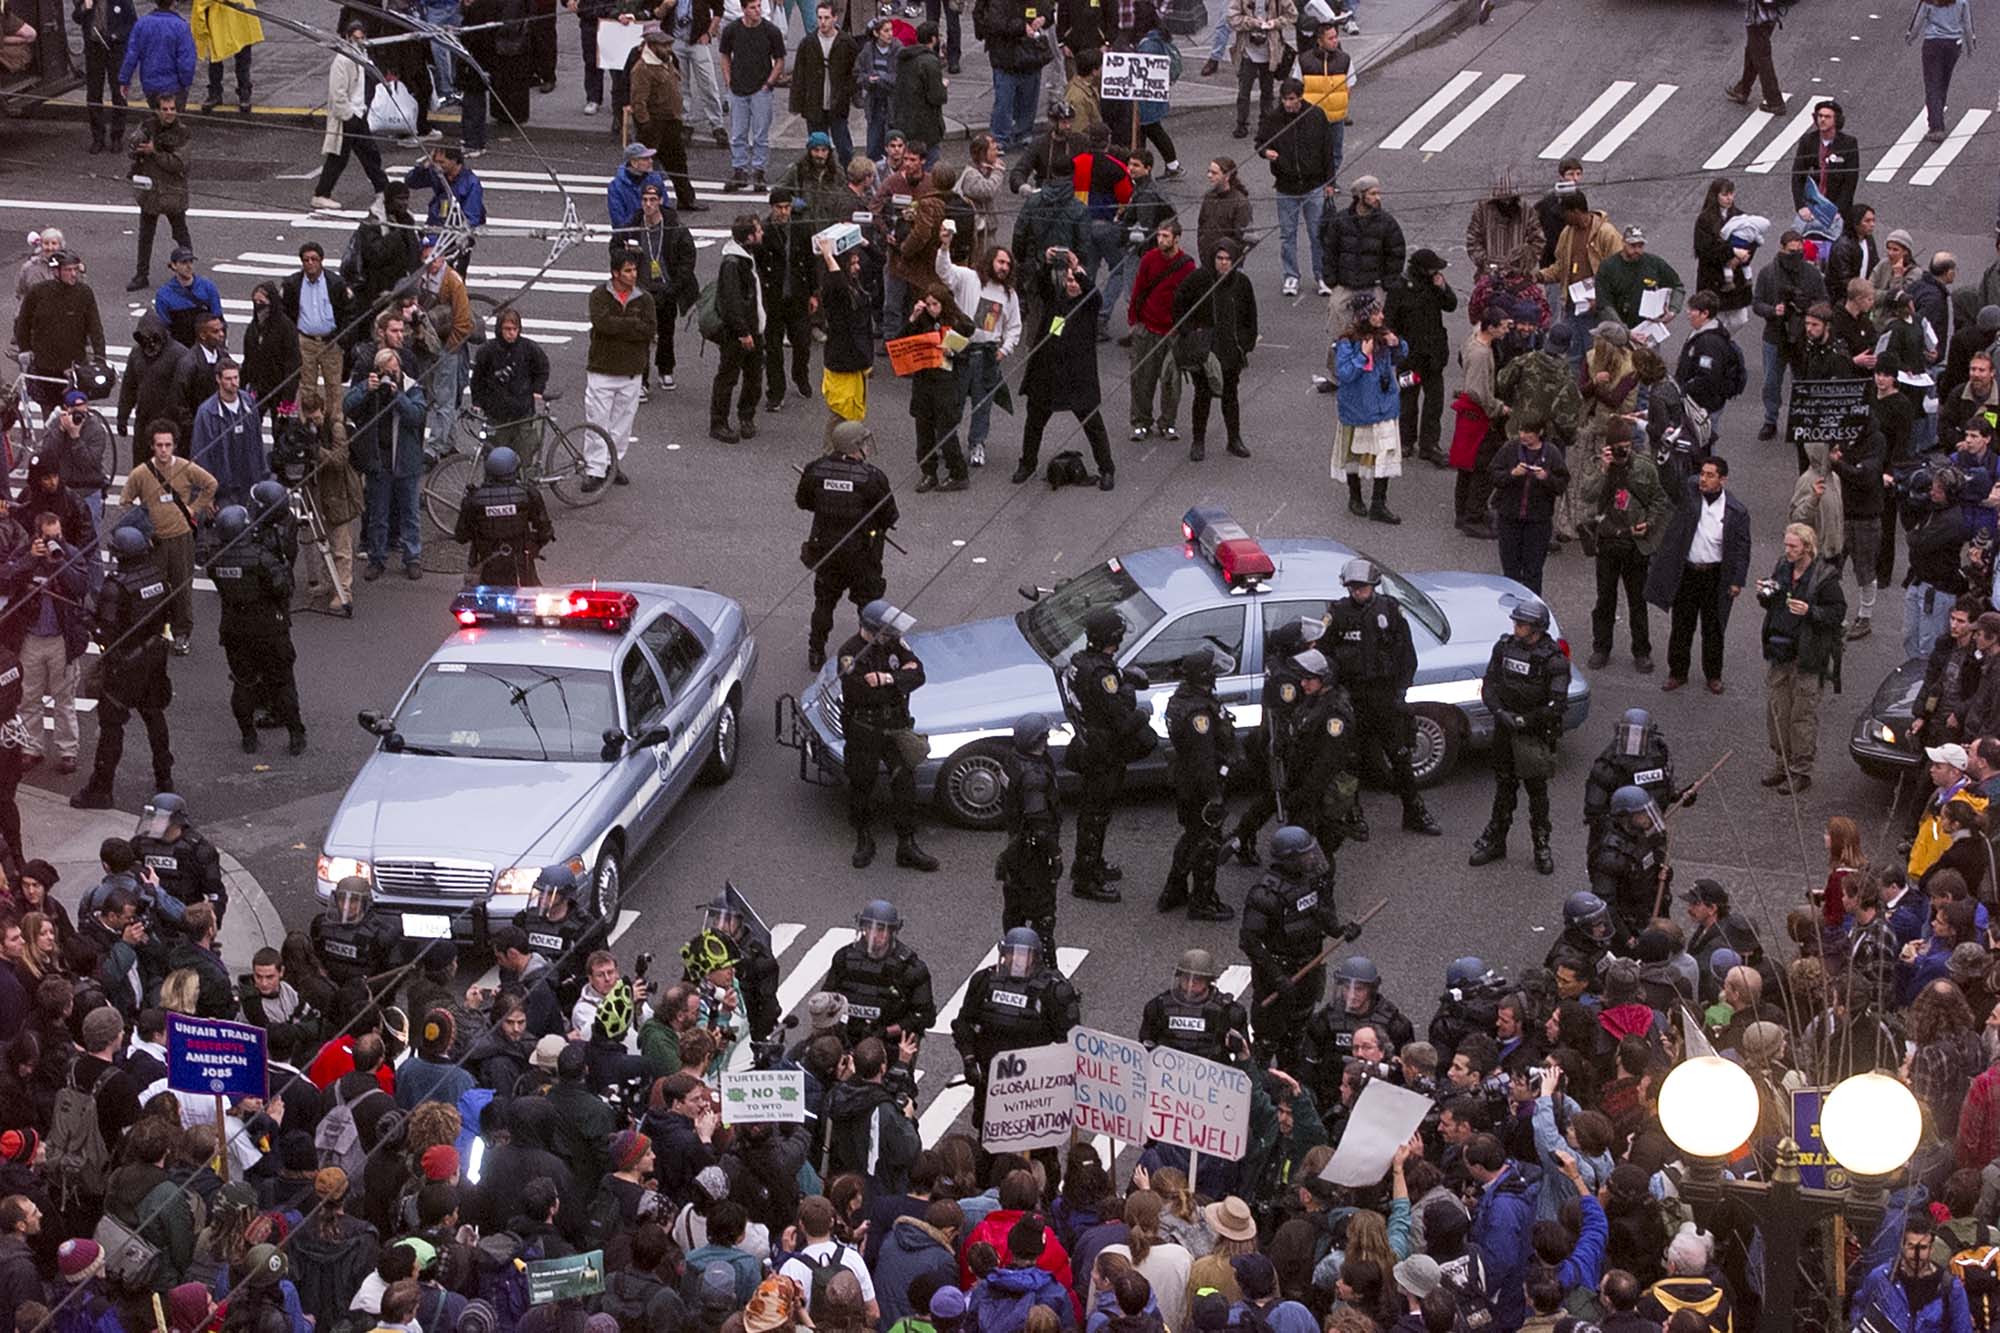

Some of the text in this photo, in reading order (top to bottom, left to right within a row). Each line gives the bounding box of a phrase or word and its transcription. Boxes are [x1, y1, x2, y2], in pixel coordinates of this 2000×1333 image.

[1106, 56, 1169, 69] NO TO WTO
[1129, 65, 1148, 79] NO
[825, 480, 851, 490] POLICE
[487, 505, 514, 515] POLICE
[1636, 771, 1660, 781] POLICE
[146, 857, 174, 867] POLICE
[530, 934, 559, 947] POLICE
[327, 942, 354, 956] POLICE
[995, 991, 1024, 1005] POLICE
[848, 1005, 877, 1017] POLICE
[1170, 1017, 1201, 1028] POLICE
[175, 1022, 257, 1043] UNFAIR TRADE
[186, 1052, 247, 1066] AMERICAN
[201, 1067, 232, 1078] JOBS
[997, 1053, 1027, 1080] NO
[1076, 1055, 1121, 1086] RULE
[1152, 1049, 1247, 1095] CORPORATE
[728, 1074, 774, 1083] TURTLES
[990, 1072, 1077, 1097] GLOBALIZATION
[752, 1088, 773, 1098] NO
[1161, 1072, 1218, 1104] RULE
[1074, 1083, 1126, 1113] IS NO
[1150, 1091, 1205, 1121] IS NO
[984, 1108, 1073, 1138] REPRESENTATION
[1074, 1103, 1143, 1147] JEWEL!
[1149, 1111, 1240, 1160] JEWEL!
